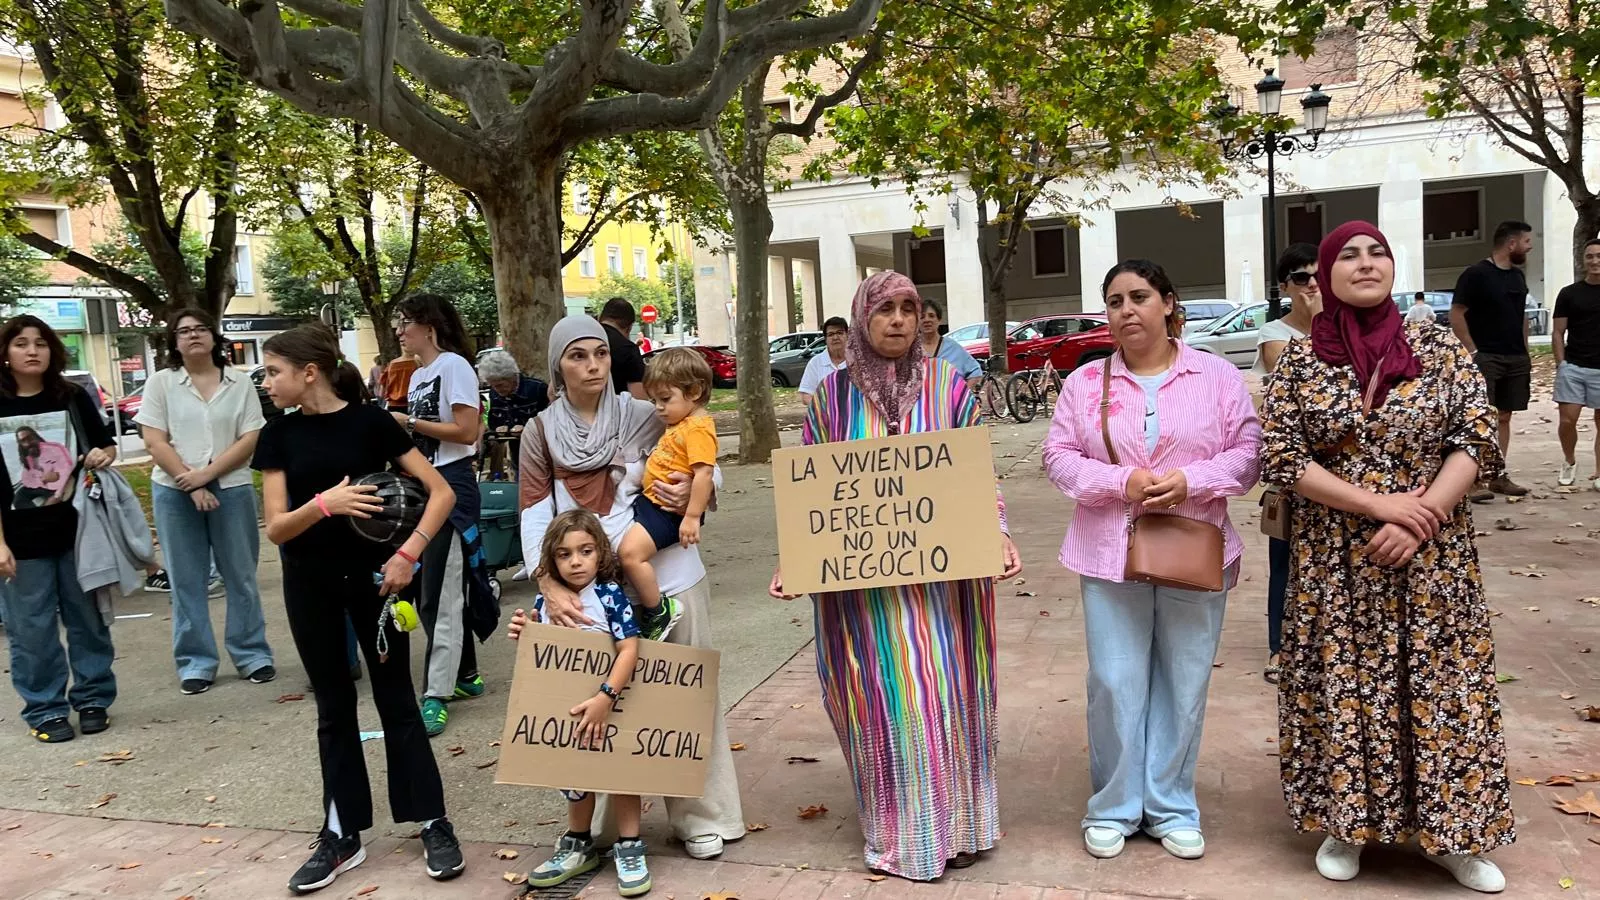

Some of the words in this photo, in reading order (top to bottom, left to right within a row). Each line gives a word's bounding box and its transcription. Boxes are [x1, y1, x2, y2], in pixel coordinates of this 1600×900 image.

[791, 457, 817, 482] LA
[831, 443, 953, 475] VIVIENDA
[833, 478, 860, 501] ES
[874, 475, 904, 498] UN
[809, 496, 934, 535] DERECHO
[843, 530, 874, 551] NO
[887, 530, 917, 550] UN
[821, 545, 949, 584] NEGOCIO
[631, 657, 704, 689] PUBLICA
[631, 727, 704, 761] SOCIAL
